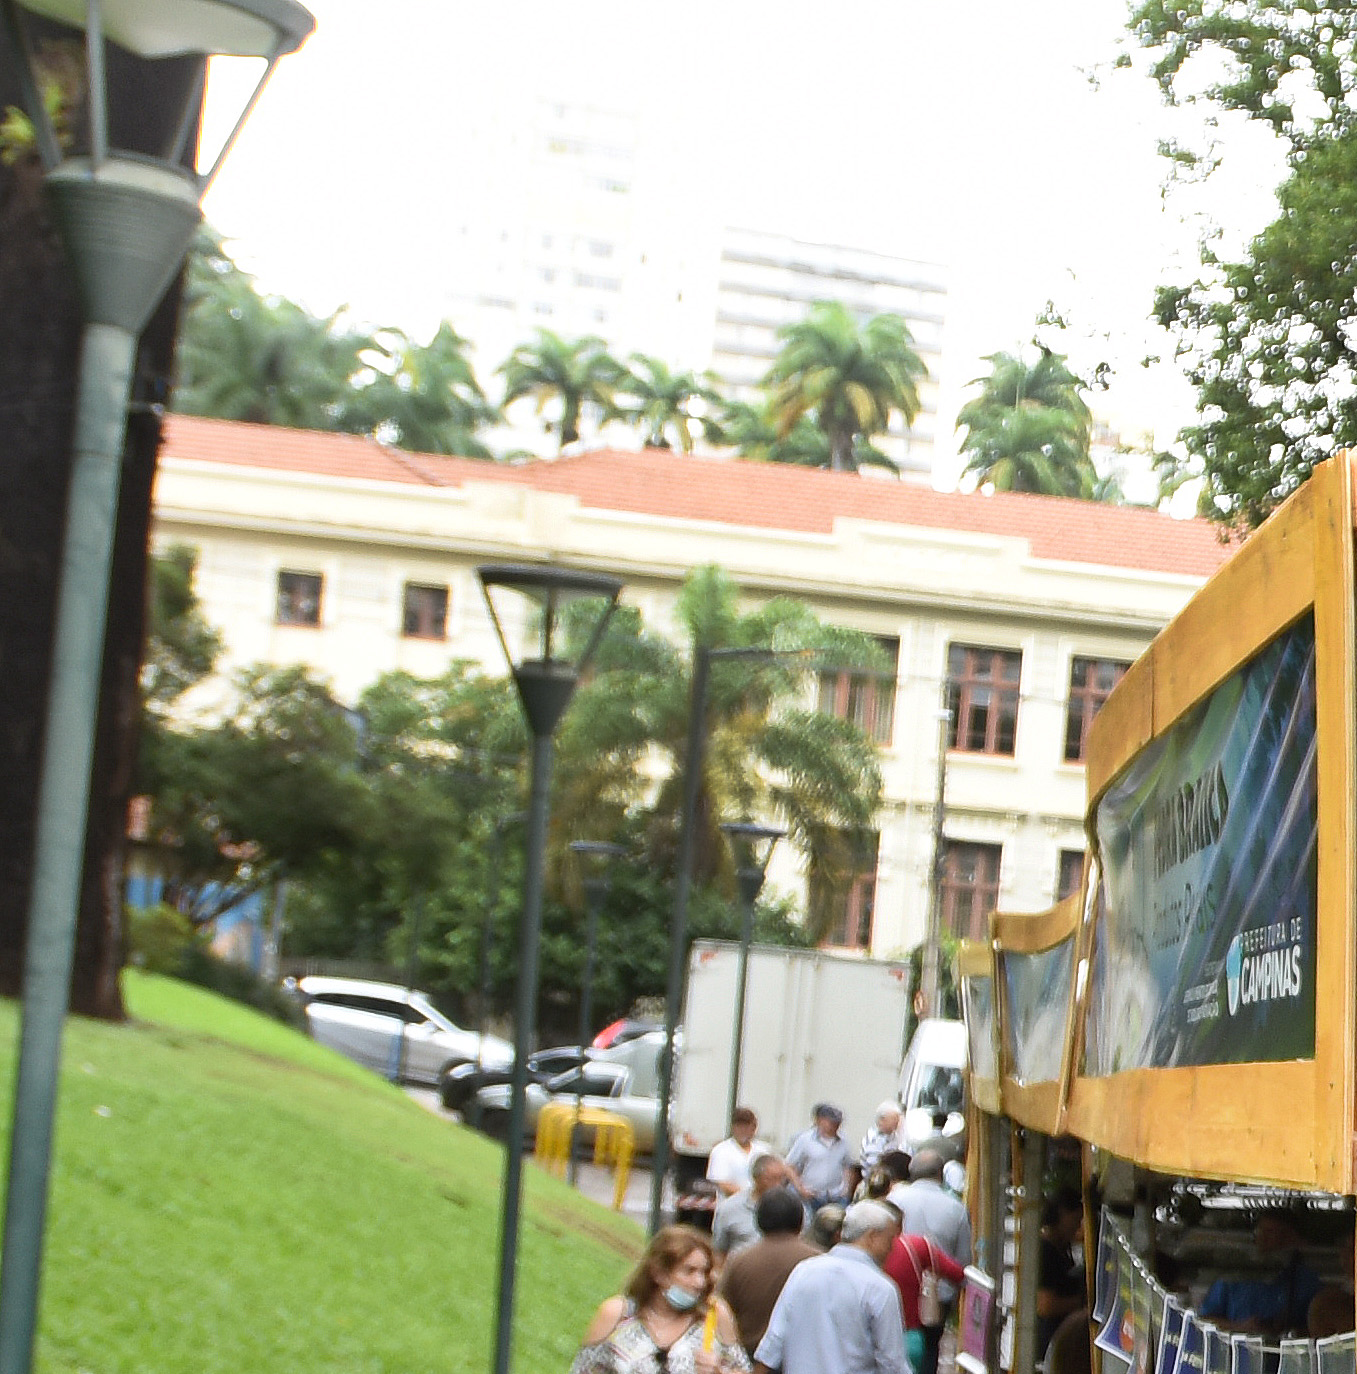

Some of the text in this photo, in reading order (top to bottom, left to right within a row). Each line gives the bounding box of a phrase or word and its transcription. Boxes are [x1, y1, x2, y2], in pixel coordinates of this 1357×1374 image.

[1238, 916, 1302, 953] PREFEITURA DE
[1241, 944, 1301, 1006] CAMPINAS
